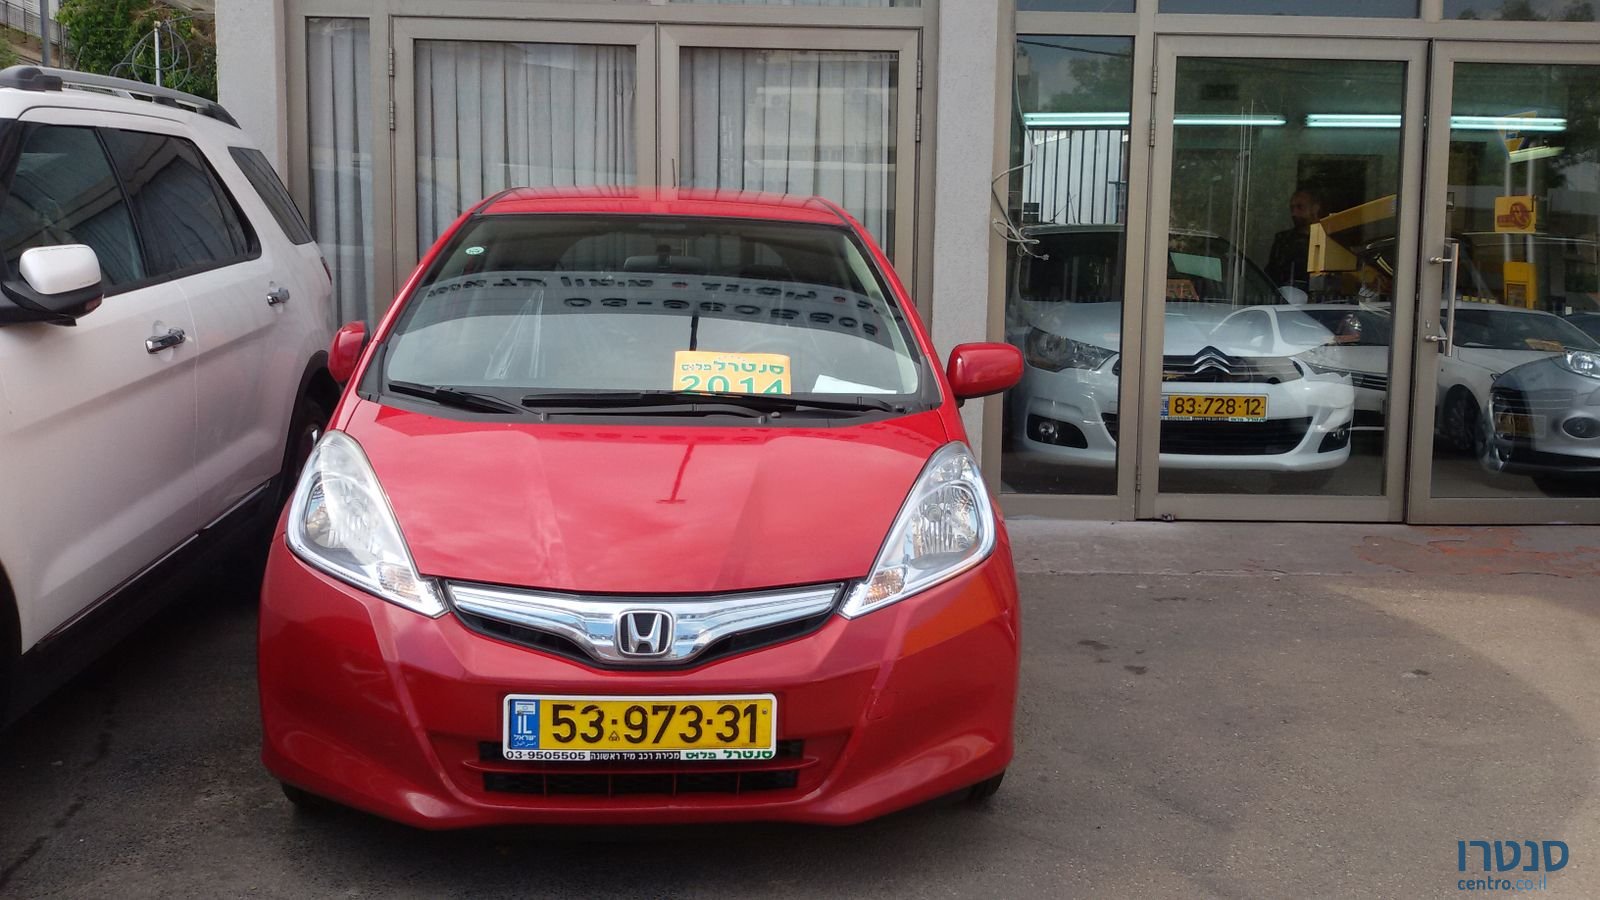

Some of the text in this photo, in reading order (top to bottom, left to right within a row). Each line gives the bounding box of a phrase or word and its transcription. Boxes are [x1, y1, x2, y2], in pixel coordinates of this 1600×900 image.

[713, 361, 785, 375] סנטרל
[518, 715, 532, 734] IL
[506, 751, 586, 760] 03-9505505
[590, 752, 621, 760] ראשונה
[638, 752, 653, 760] רכב
[655, 752, 680, 760] מכירת
[685, 750, 773, 759] סנטרל פלוס
